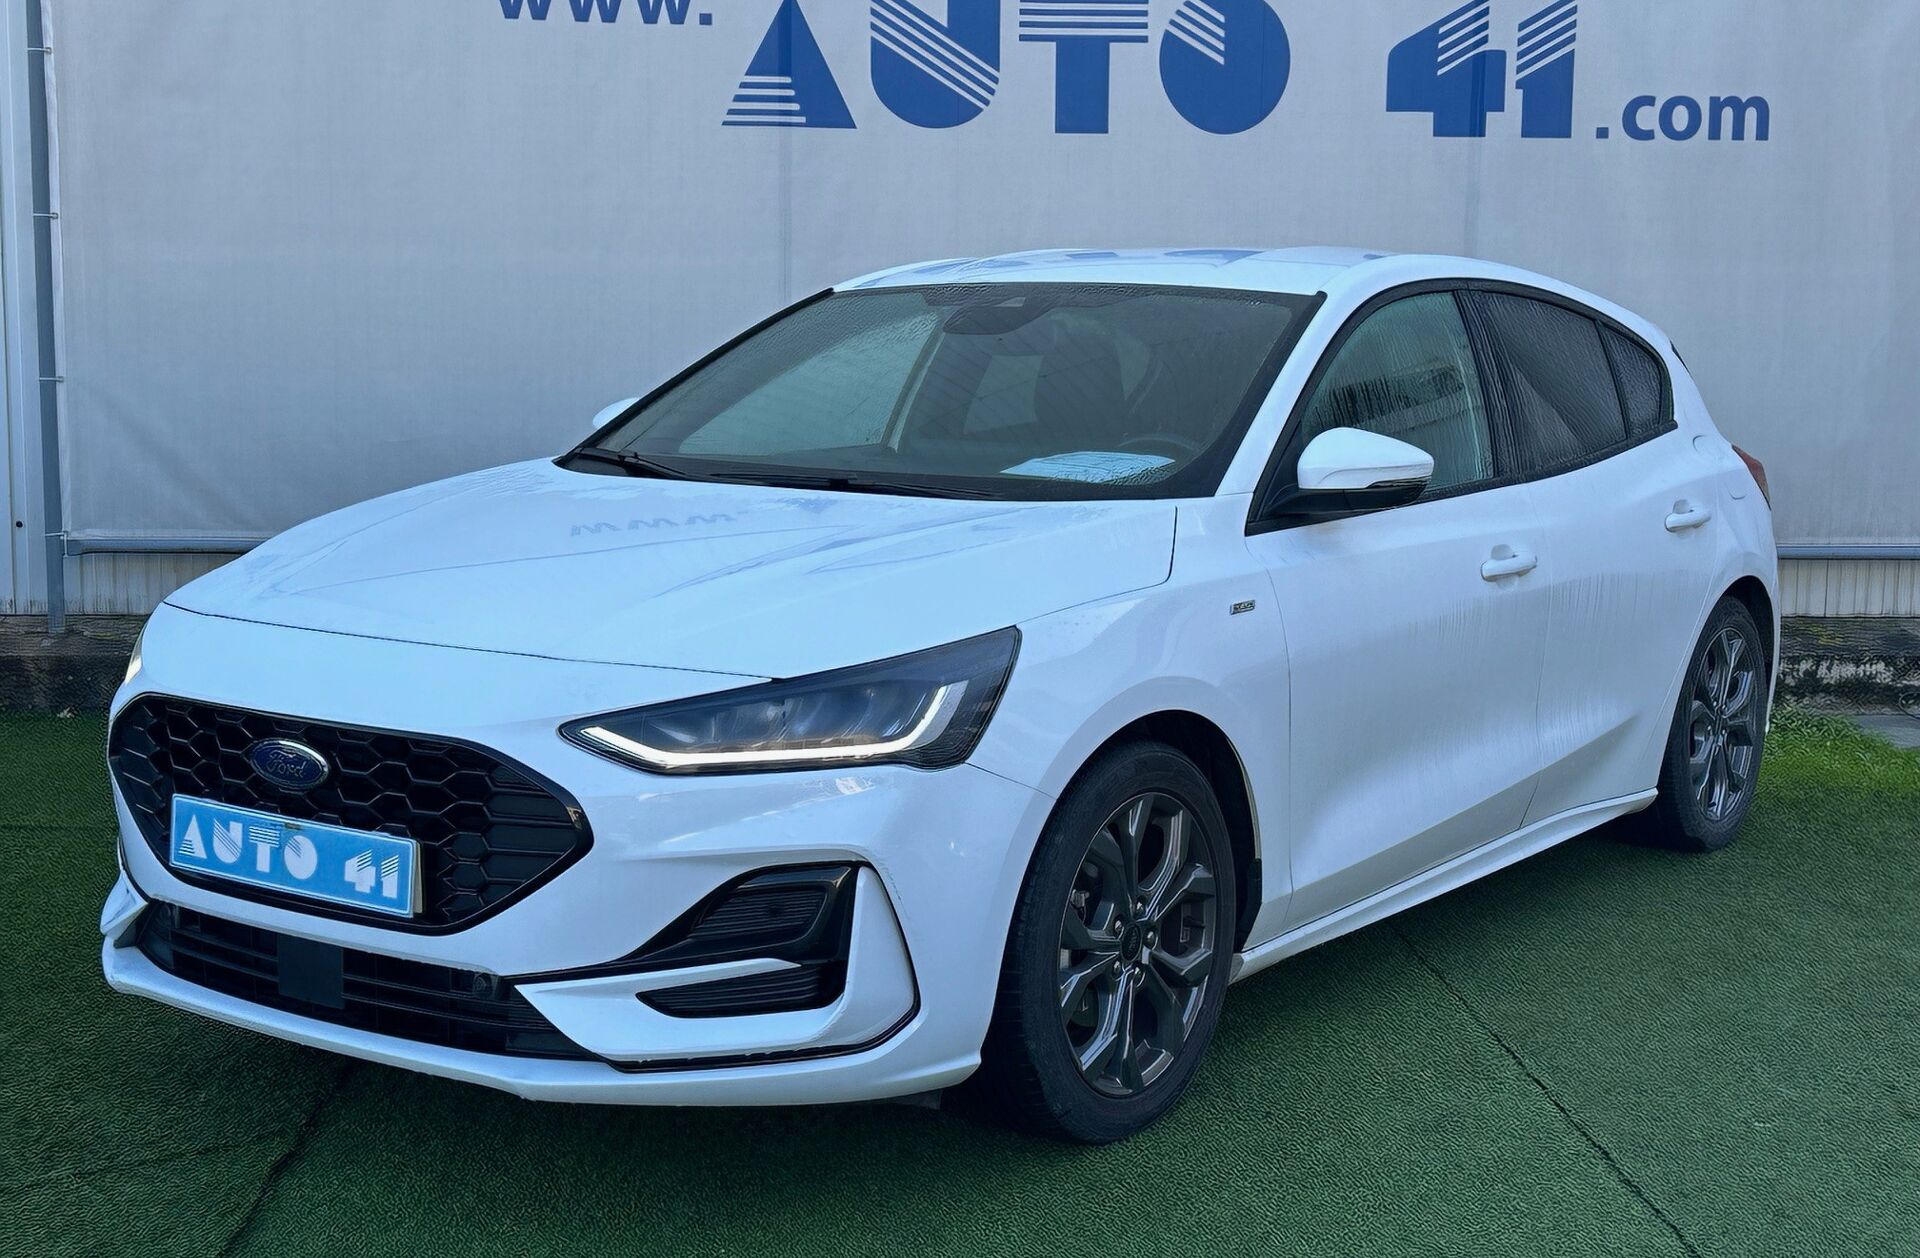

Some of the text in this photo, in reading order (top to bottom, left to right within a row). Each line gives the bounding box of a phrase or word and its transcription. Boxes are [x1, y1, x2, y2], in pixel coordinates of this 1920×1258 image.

[721, 0, 1291, 135] AUTO
[1386, 0, 1577, 138] 41
[1595, 95, 1770, 142] .com
[266, 749, 308, 779] Ford
[177, 813, 400, 899] AUTO 41
